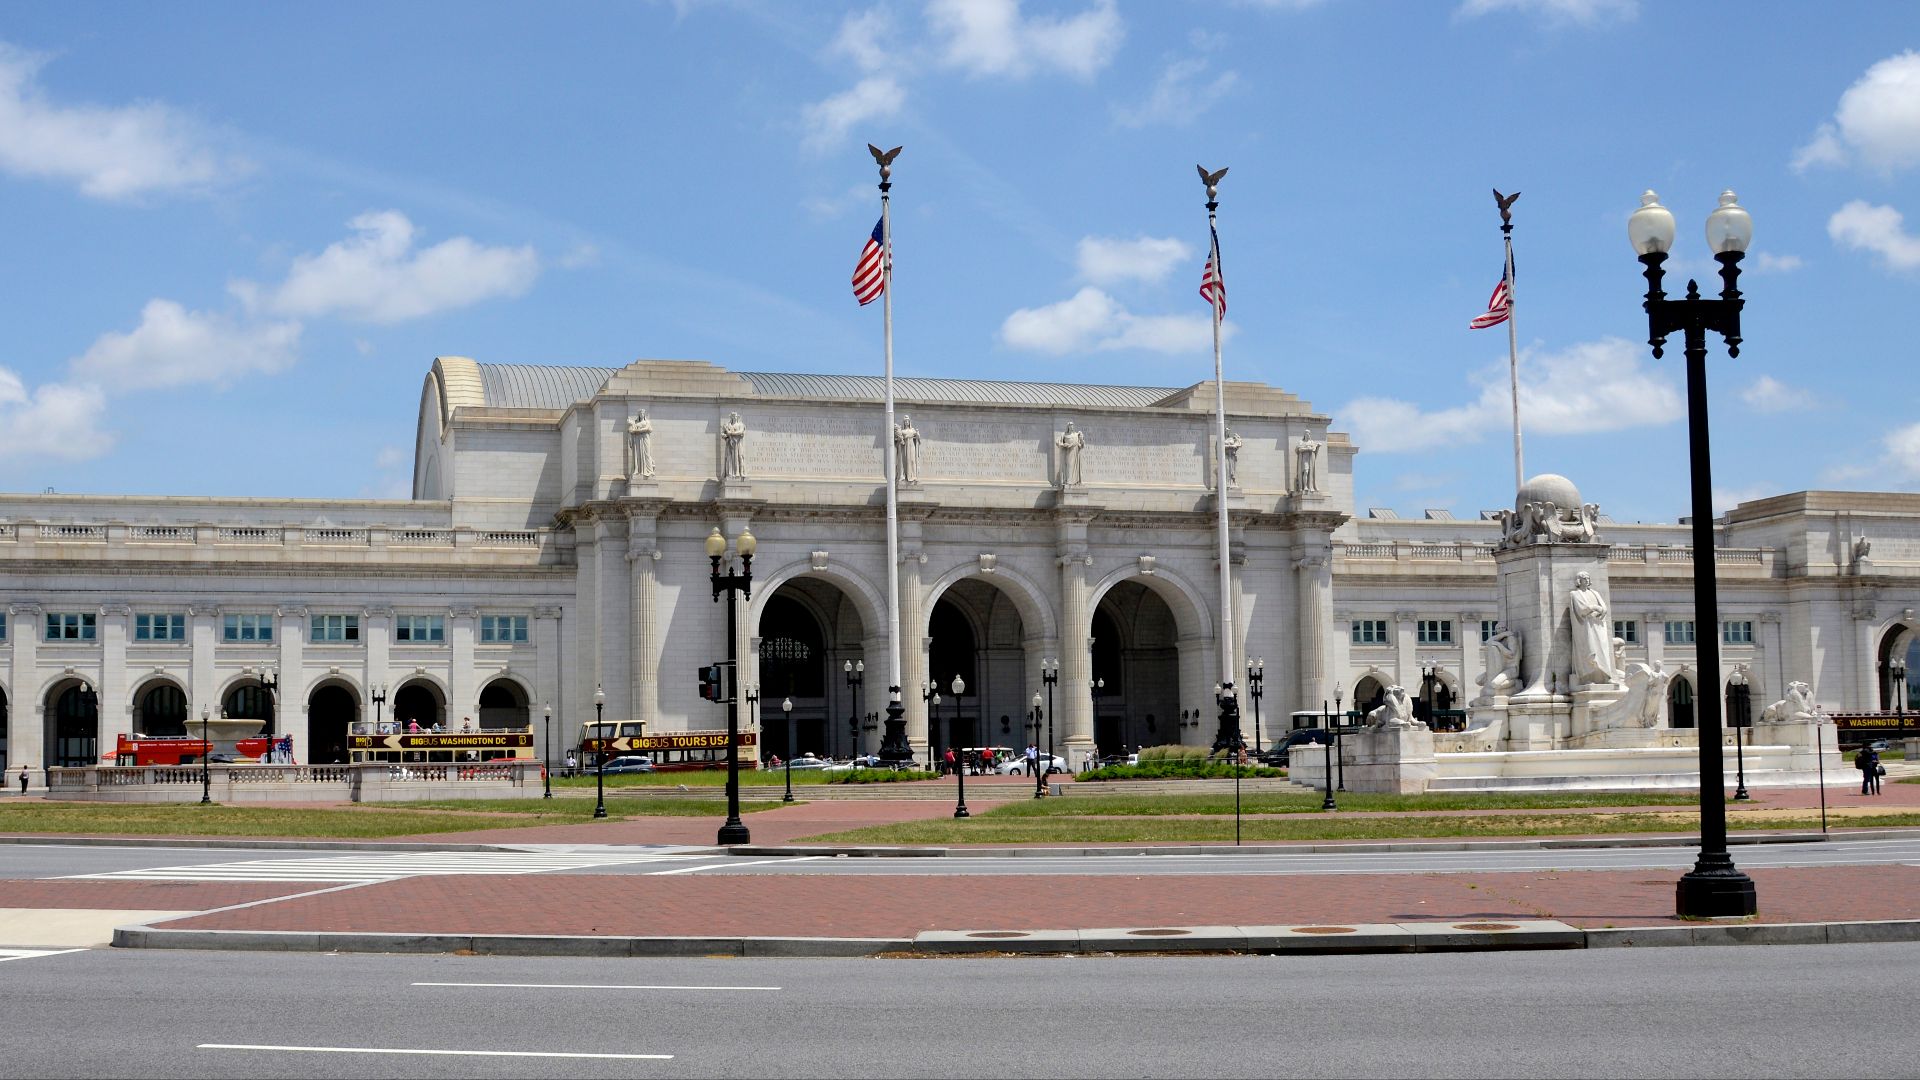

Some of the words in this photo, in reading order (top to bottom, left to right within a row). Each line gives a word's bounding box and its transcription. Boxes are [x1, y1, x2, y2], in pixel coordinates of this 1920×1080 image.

[440, 737, 494, 745] WASHINGTON
[495, 737, 506, 745] DC
[672, 735, 707, 747] TOURS
[709, 735, 729, 746] USA
